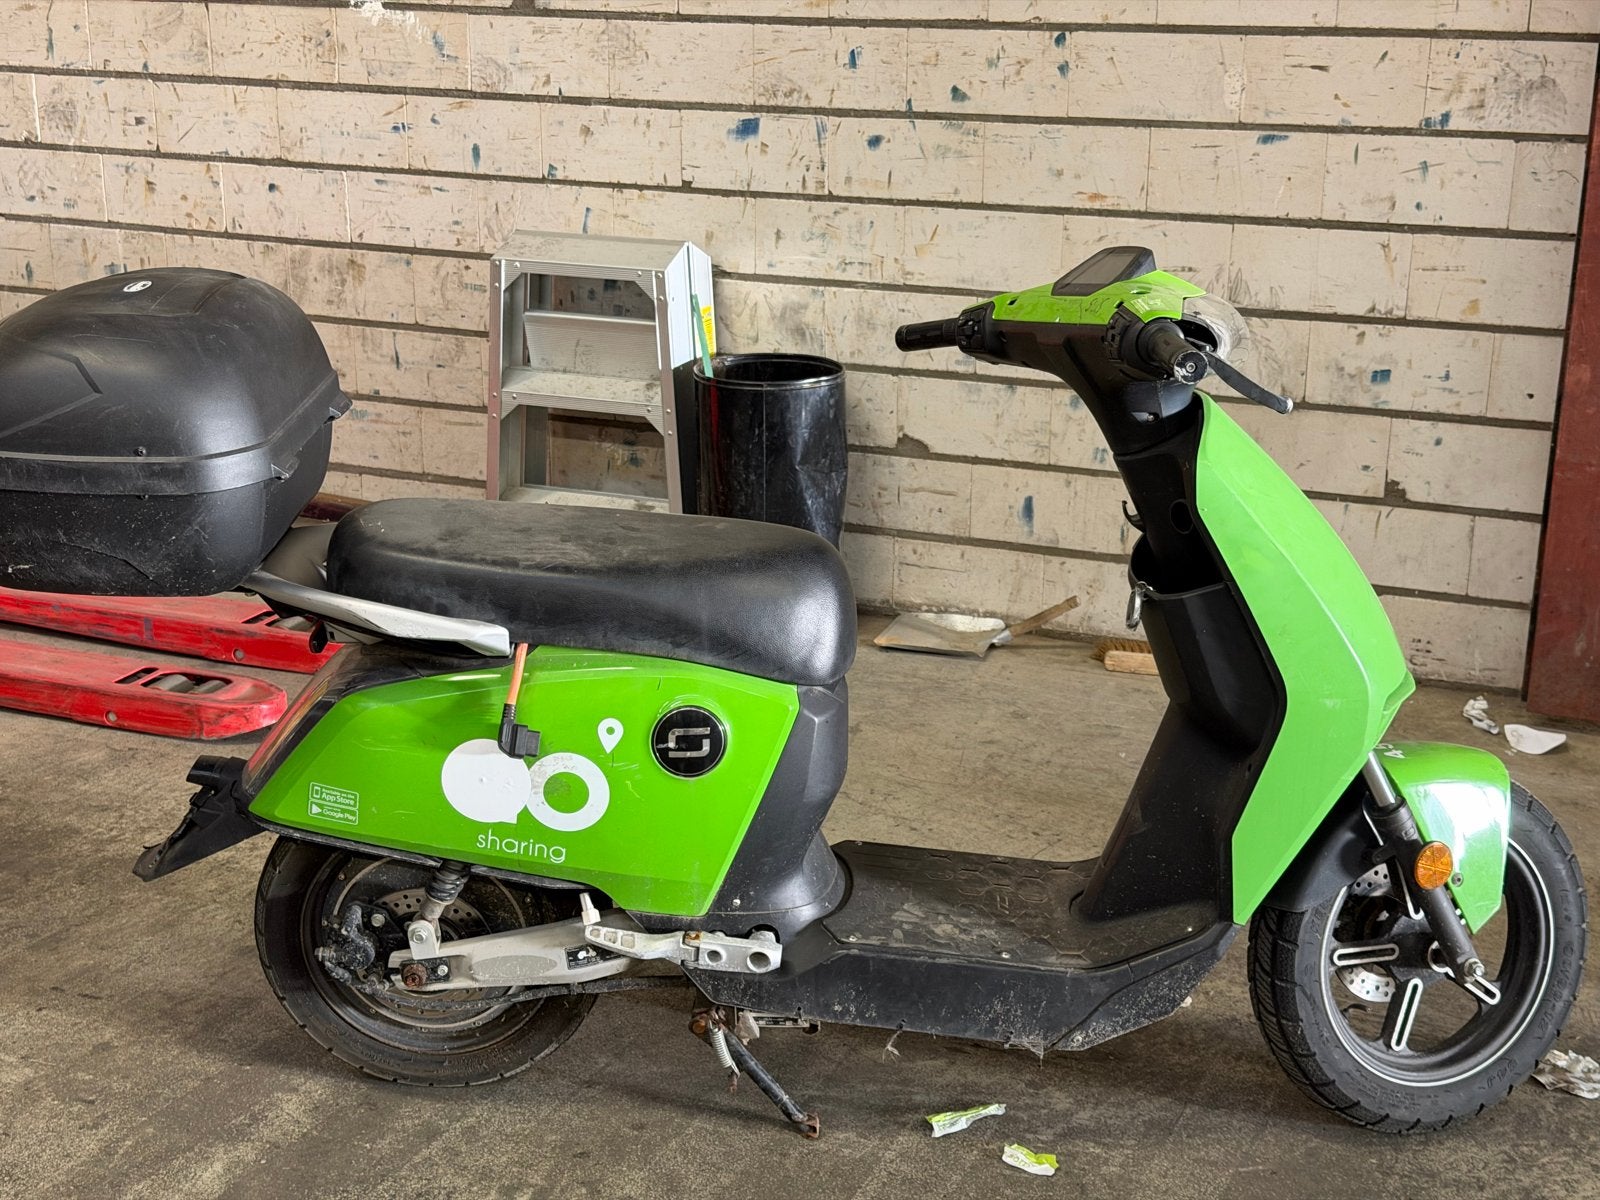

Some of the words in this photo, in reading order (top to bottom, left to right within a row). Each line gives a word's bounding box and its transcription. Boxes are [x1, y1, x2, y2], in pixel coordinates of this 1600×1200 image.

[322, 793, 336, 802] App
[336, 795, 355, 806] Store
[323, 808, 344, 818] Google
[344, 813, 356, 821] Play
[476, 828, 566, 864] sharing
